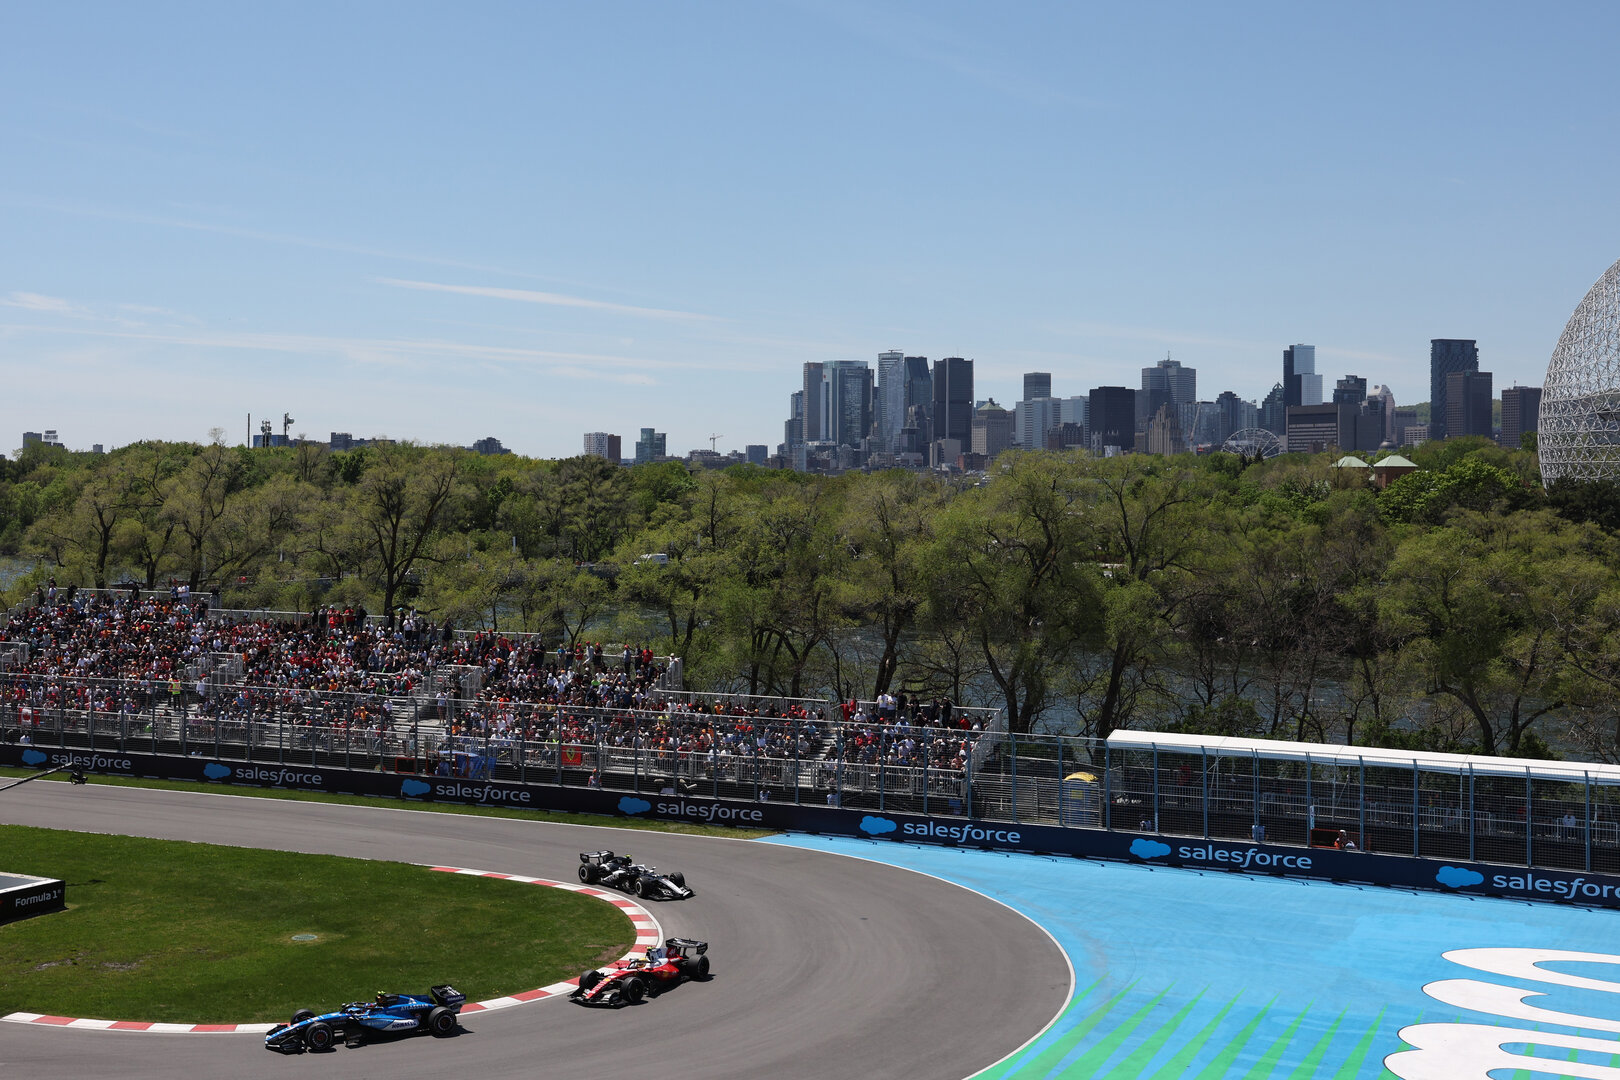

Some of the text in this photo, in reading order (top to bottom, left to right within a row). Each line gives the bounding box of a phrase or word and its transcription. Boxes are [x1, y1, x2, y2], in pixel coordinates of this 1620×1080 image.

[51, 752, 132, 770] salesforce
[236, 766, 322, 785] salesforce
[435, 783, 531, 802] salesforce
[657, 800, 763, 821] salesforce
[903, 821, 1021, 843] salesforce
[1178, 844, 1312, 869] salesforce
[15, 892, 52, 907] Formula
